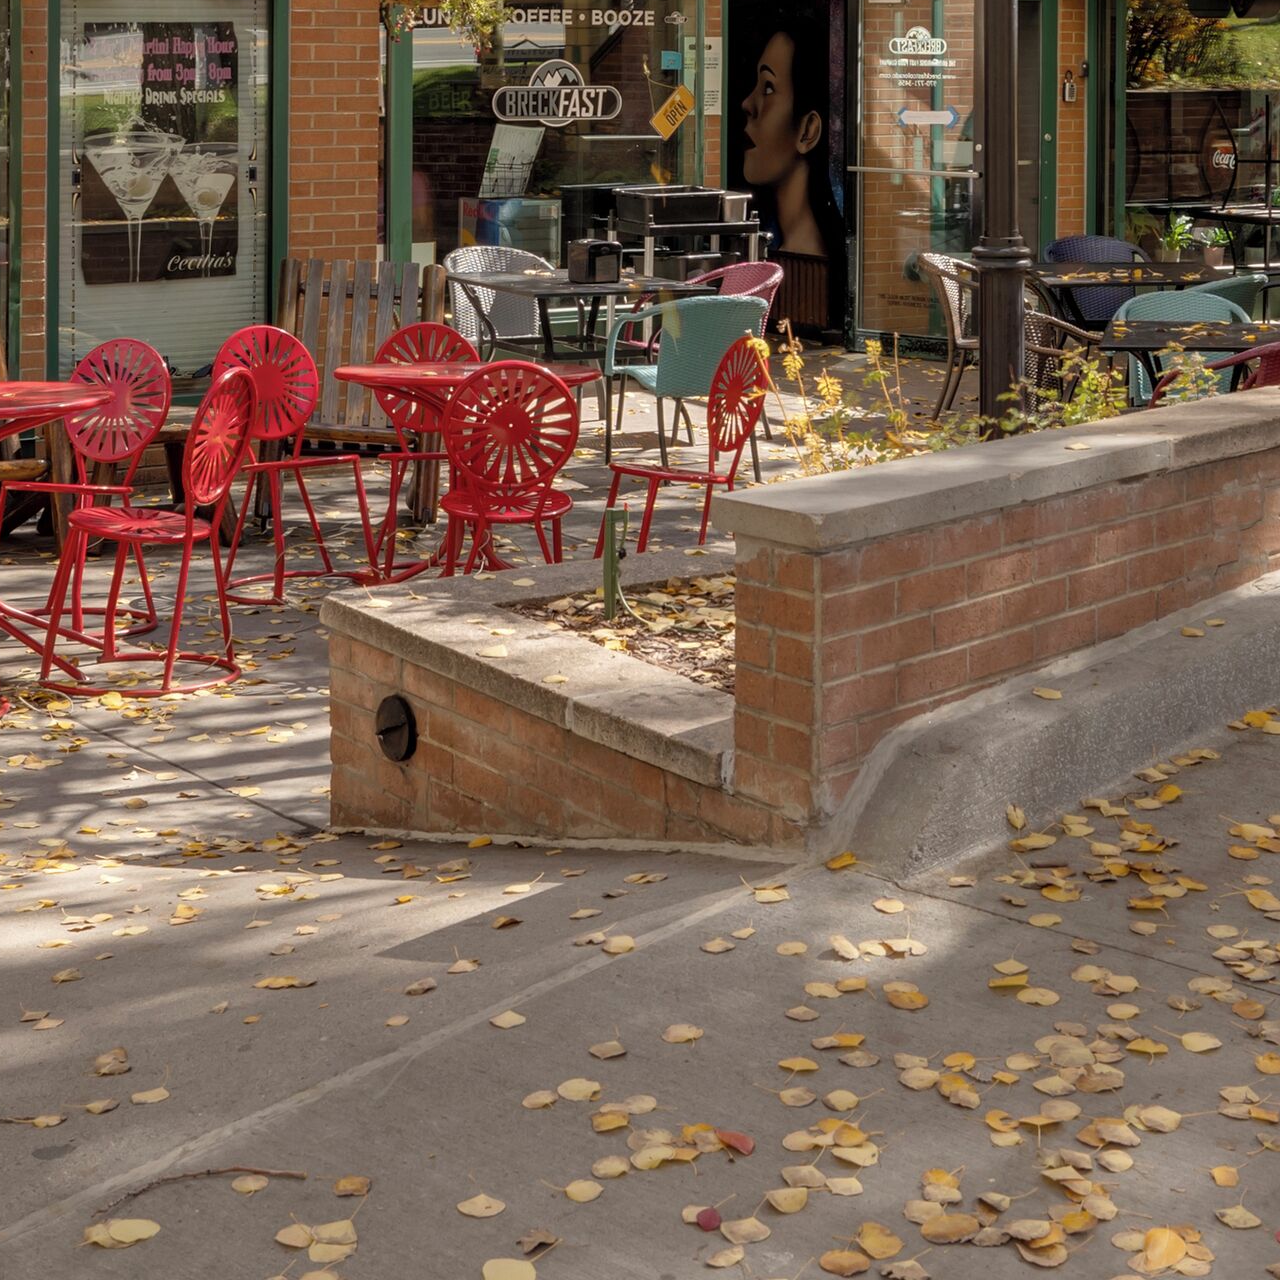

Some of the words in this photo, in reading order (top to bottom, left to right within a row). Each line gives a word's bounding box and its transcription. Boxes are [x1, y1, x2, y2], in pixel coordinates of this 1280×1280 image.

[504, 8, 573, 26] OFFEE
[591, 9, 655, 26] BOOZE
[207, 36, 234, 54] Hour
[147, 63, 173, 81] from
[208, 62, 232, 83] 8pm
[505, 88, 607, 118] BRECKFAST
[665, 99, 688, 127] OPEN
[167, 251, 233, 272] Cecilia's
